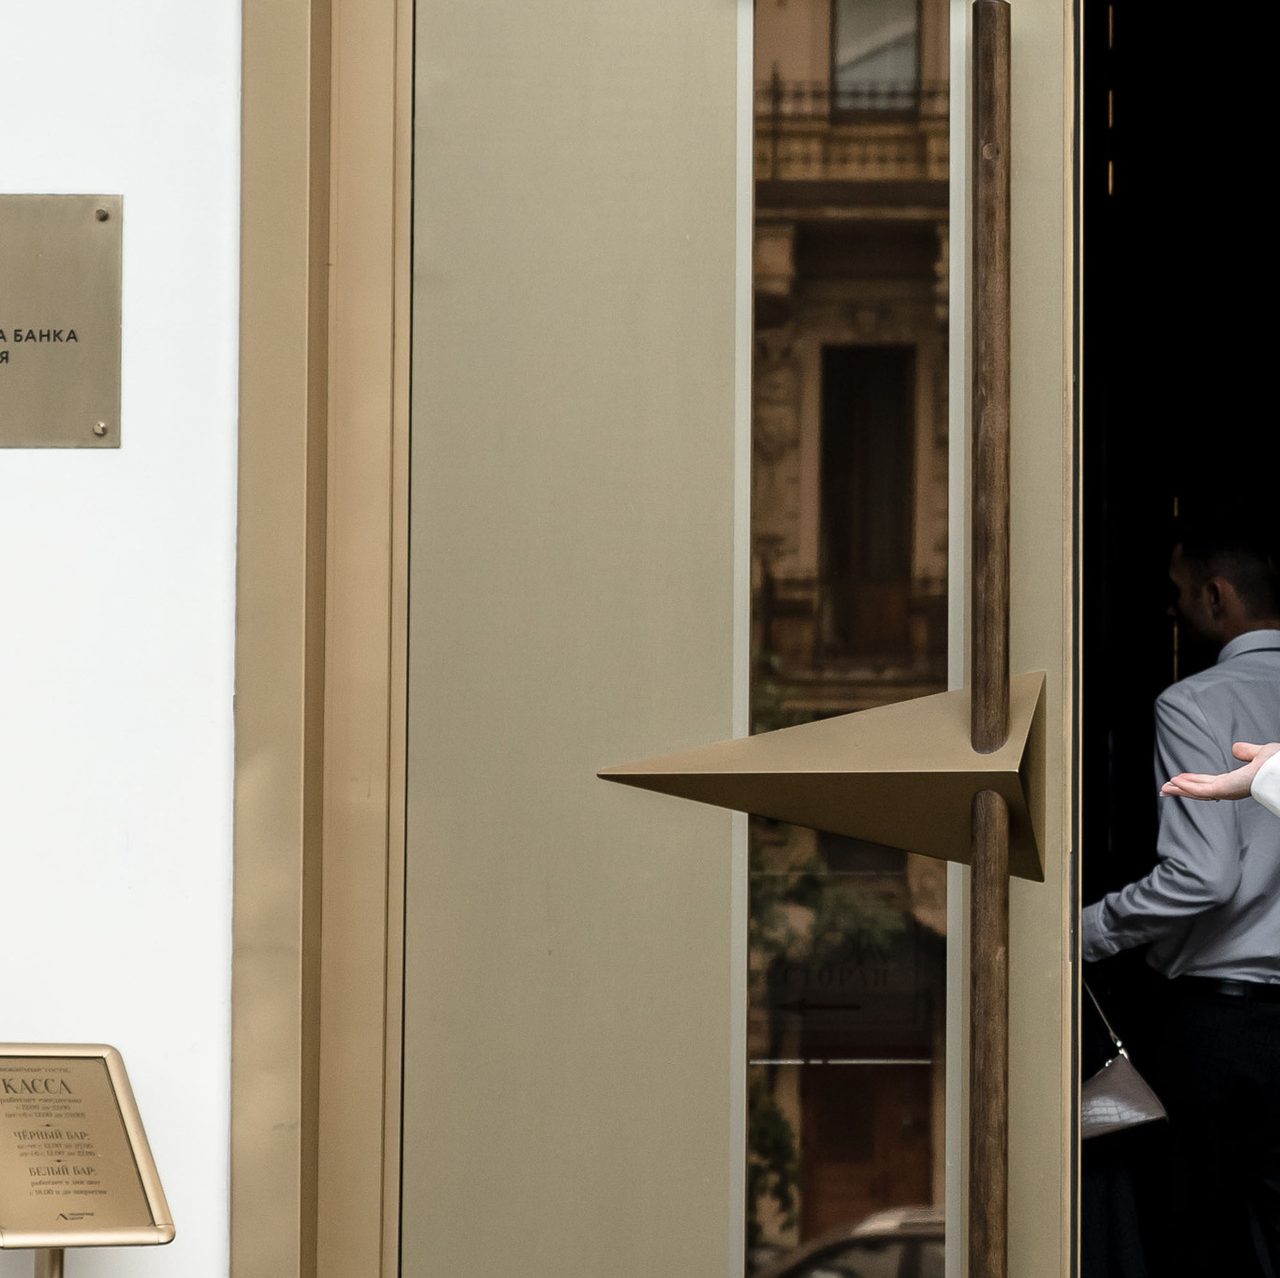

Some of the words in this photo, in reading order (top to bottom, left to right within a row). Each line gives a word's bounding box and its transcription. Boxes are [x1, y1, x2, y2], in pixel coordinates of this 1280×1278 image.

[14, 329, 78, 343] БАНКА
[2, 1078, 73, 1094] КАССА
[28, 1165, 69, 1176] БЕЛЫЙ
